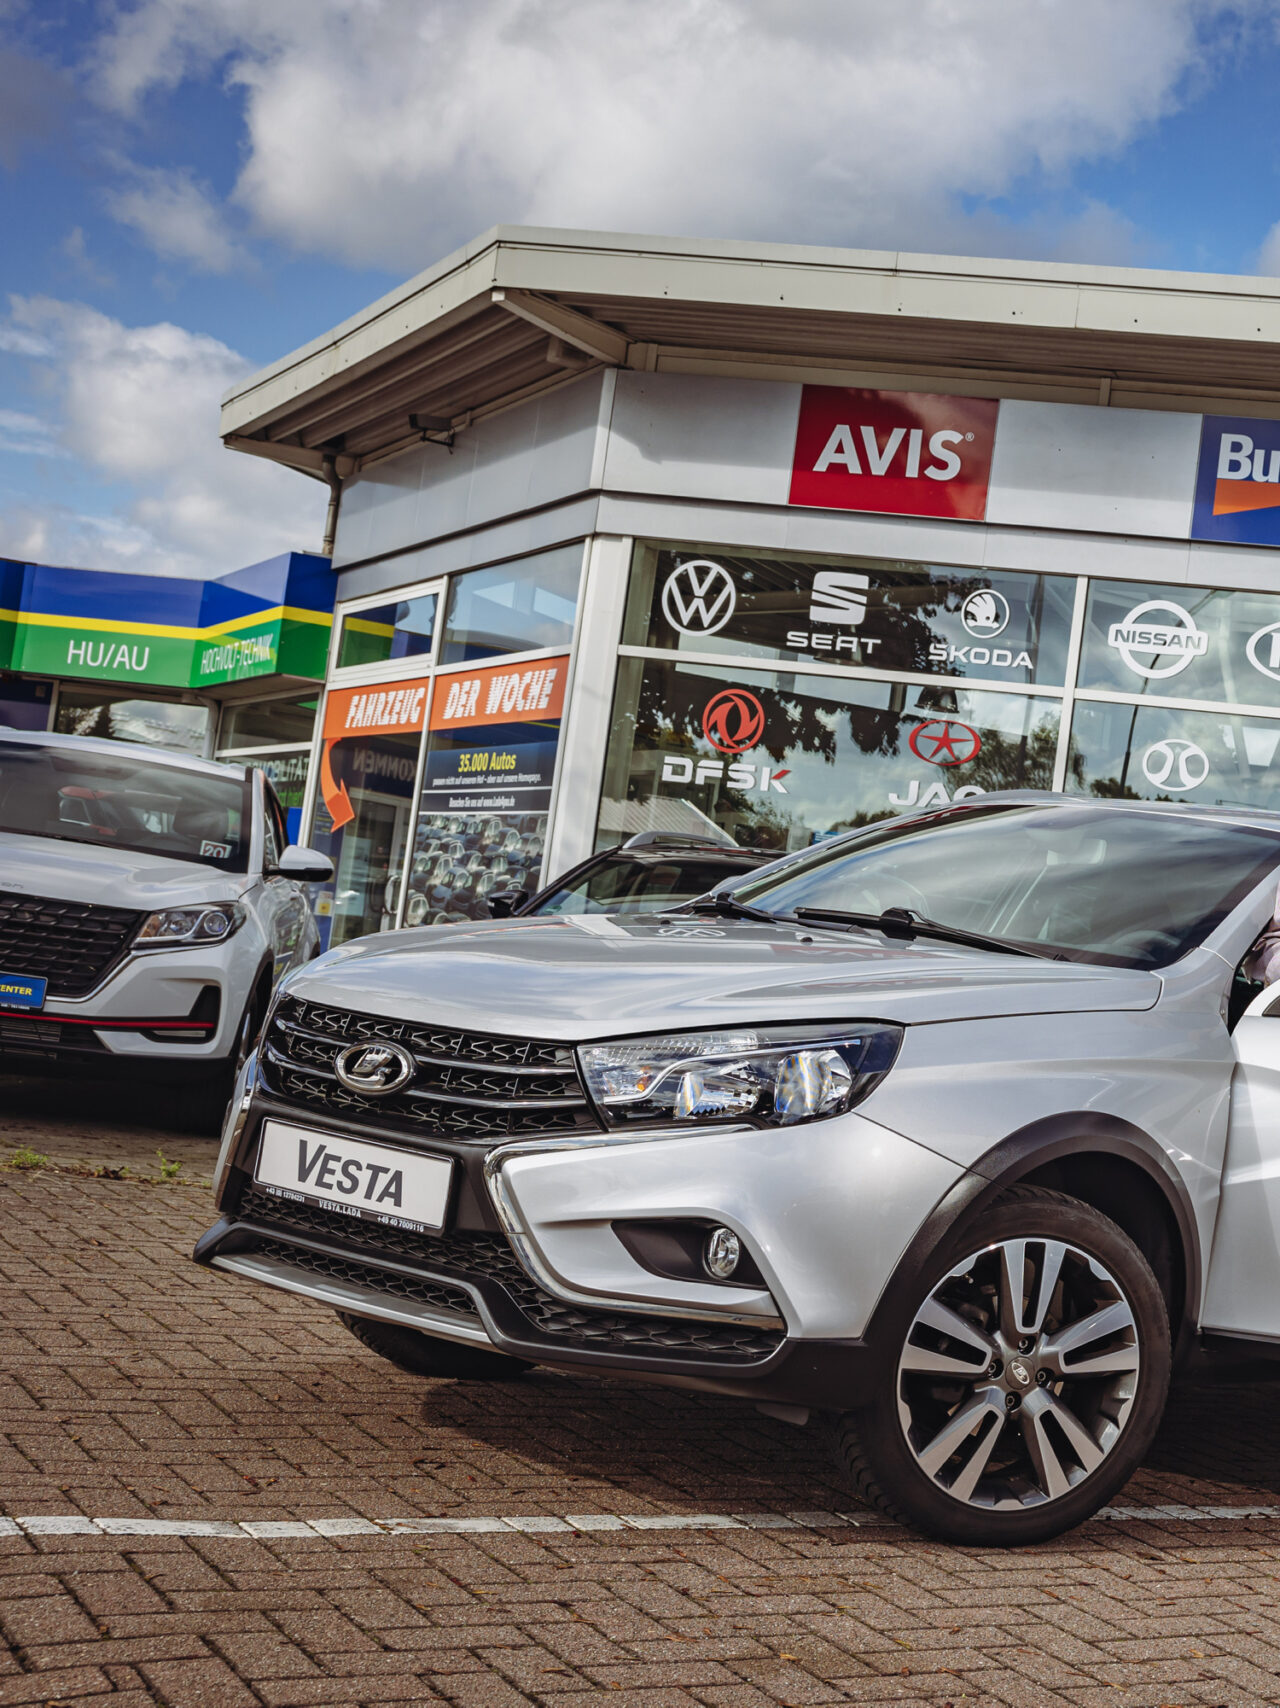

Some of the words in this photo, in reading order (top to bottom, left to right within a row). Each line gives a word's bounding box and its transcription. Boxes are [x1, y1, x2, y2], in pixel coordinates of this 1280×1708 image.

[200, 633, 274, 675] HOCHVOLT-TECHNIK
[786, 631, 881, 655] SEAT
[1114, 628, 1201, 649] NISSAN
[67, 639, 149, 671] HU/AU
[345, 687, 426, 728] FAHRZEUG
[442, 679, 481, 719] DER
[485, 668, 558, 715] WOCHE
[458, 752, 490, 773] 35.000
[489, 752, 517, 771] Autos
[661, 755, 791, 794] DFSK
[297, 1138, 404, 1208] VESTA
[318, 1200, 362, 1218] VESTA.LADA
